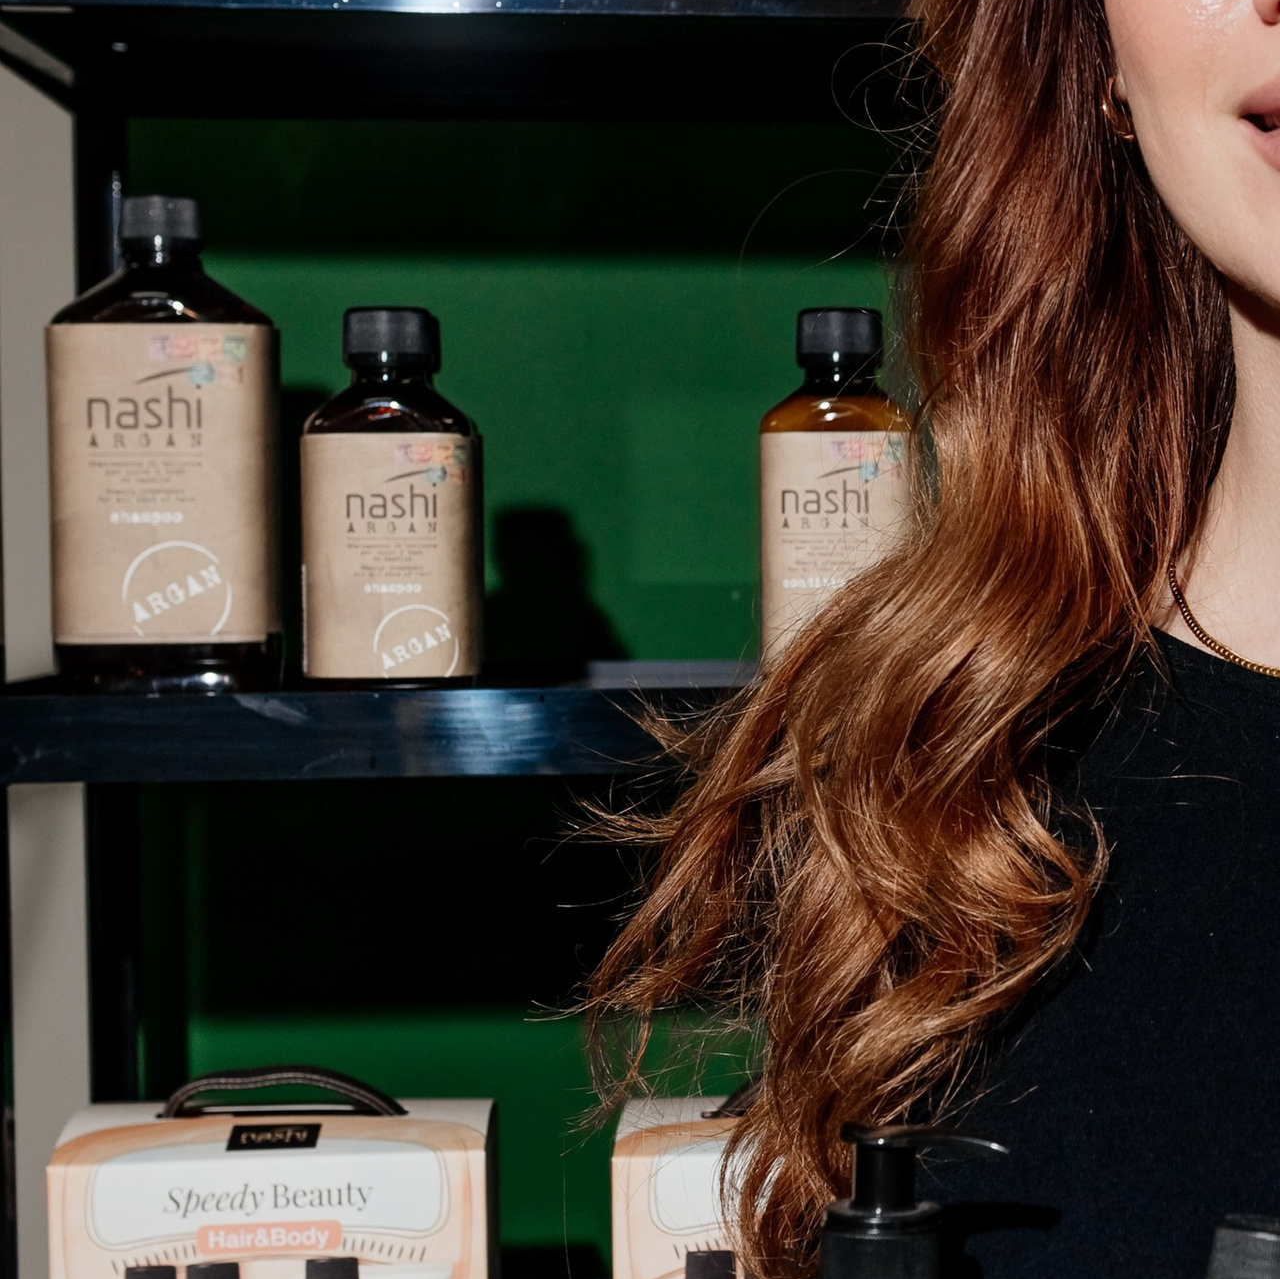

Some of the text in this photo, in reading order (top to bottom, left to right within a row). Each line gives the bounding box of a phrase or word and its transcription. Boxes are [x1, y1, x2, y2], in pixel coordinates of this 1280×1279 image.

[87, 384, 202, 429] nashi
[87, 432, 202, 449] ARGAN
[346, 482, 437, 519] nashi
[781, 479, 869, 514] nashi
[109, 509, 184, 526] shampoo
[346, 521, 437, 534] ARGAN
[132, 563, 222, 624] ARGAN
[364, 582, 422, 595] shampoo
[381, 623, 452, 670] ARGAN
[163, 1180, 374, 1219] Speedy Beauty
[206, 1226, 331, 1253] Hair&Body
